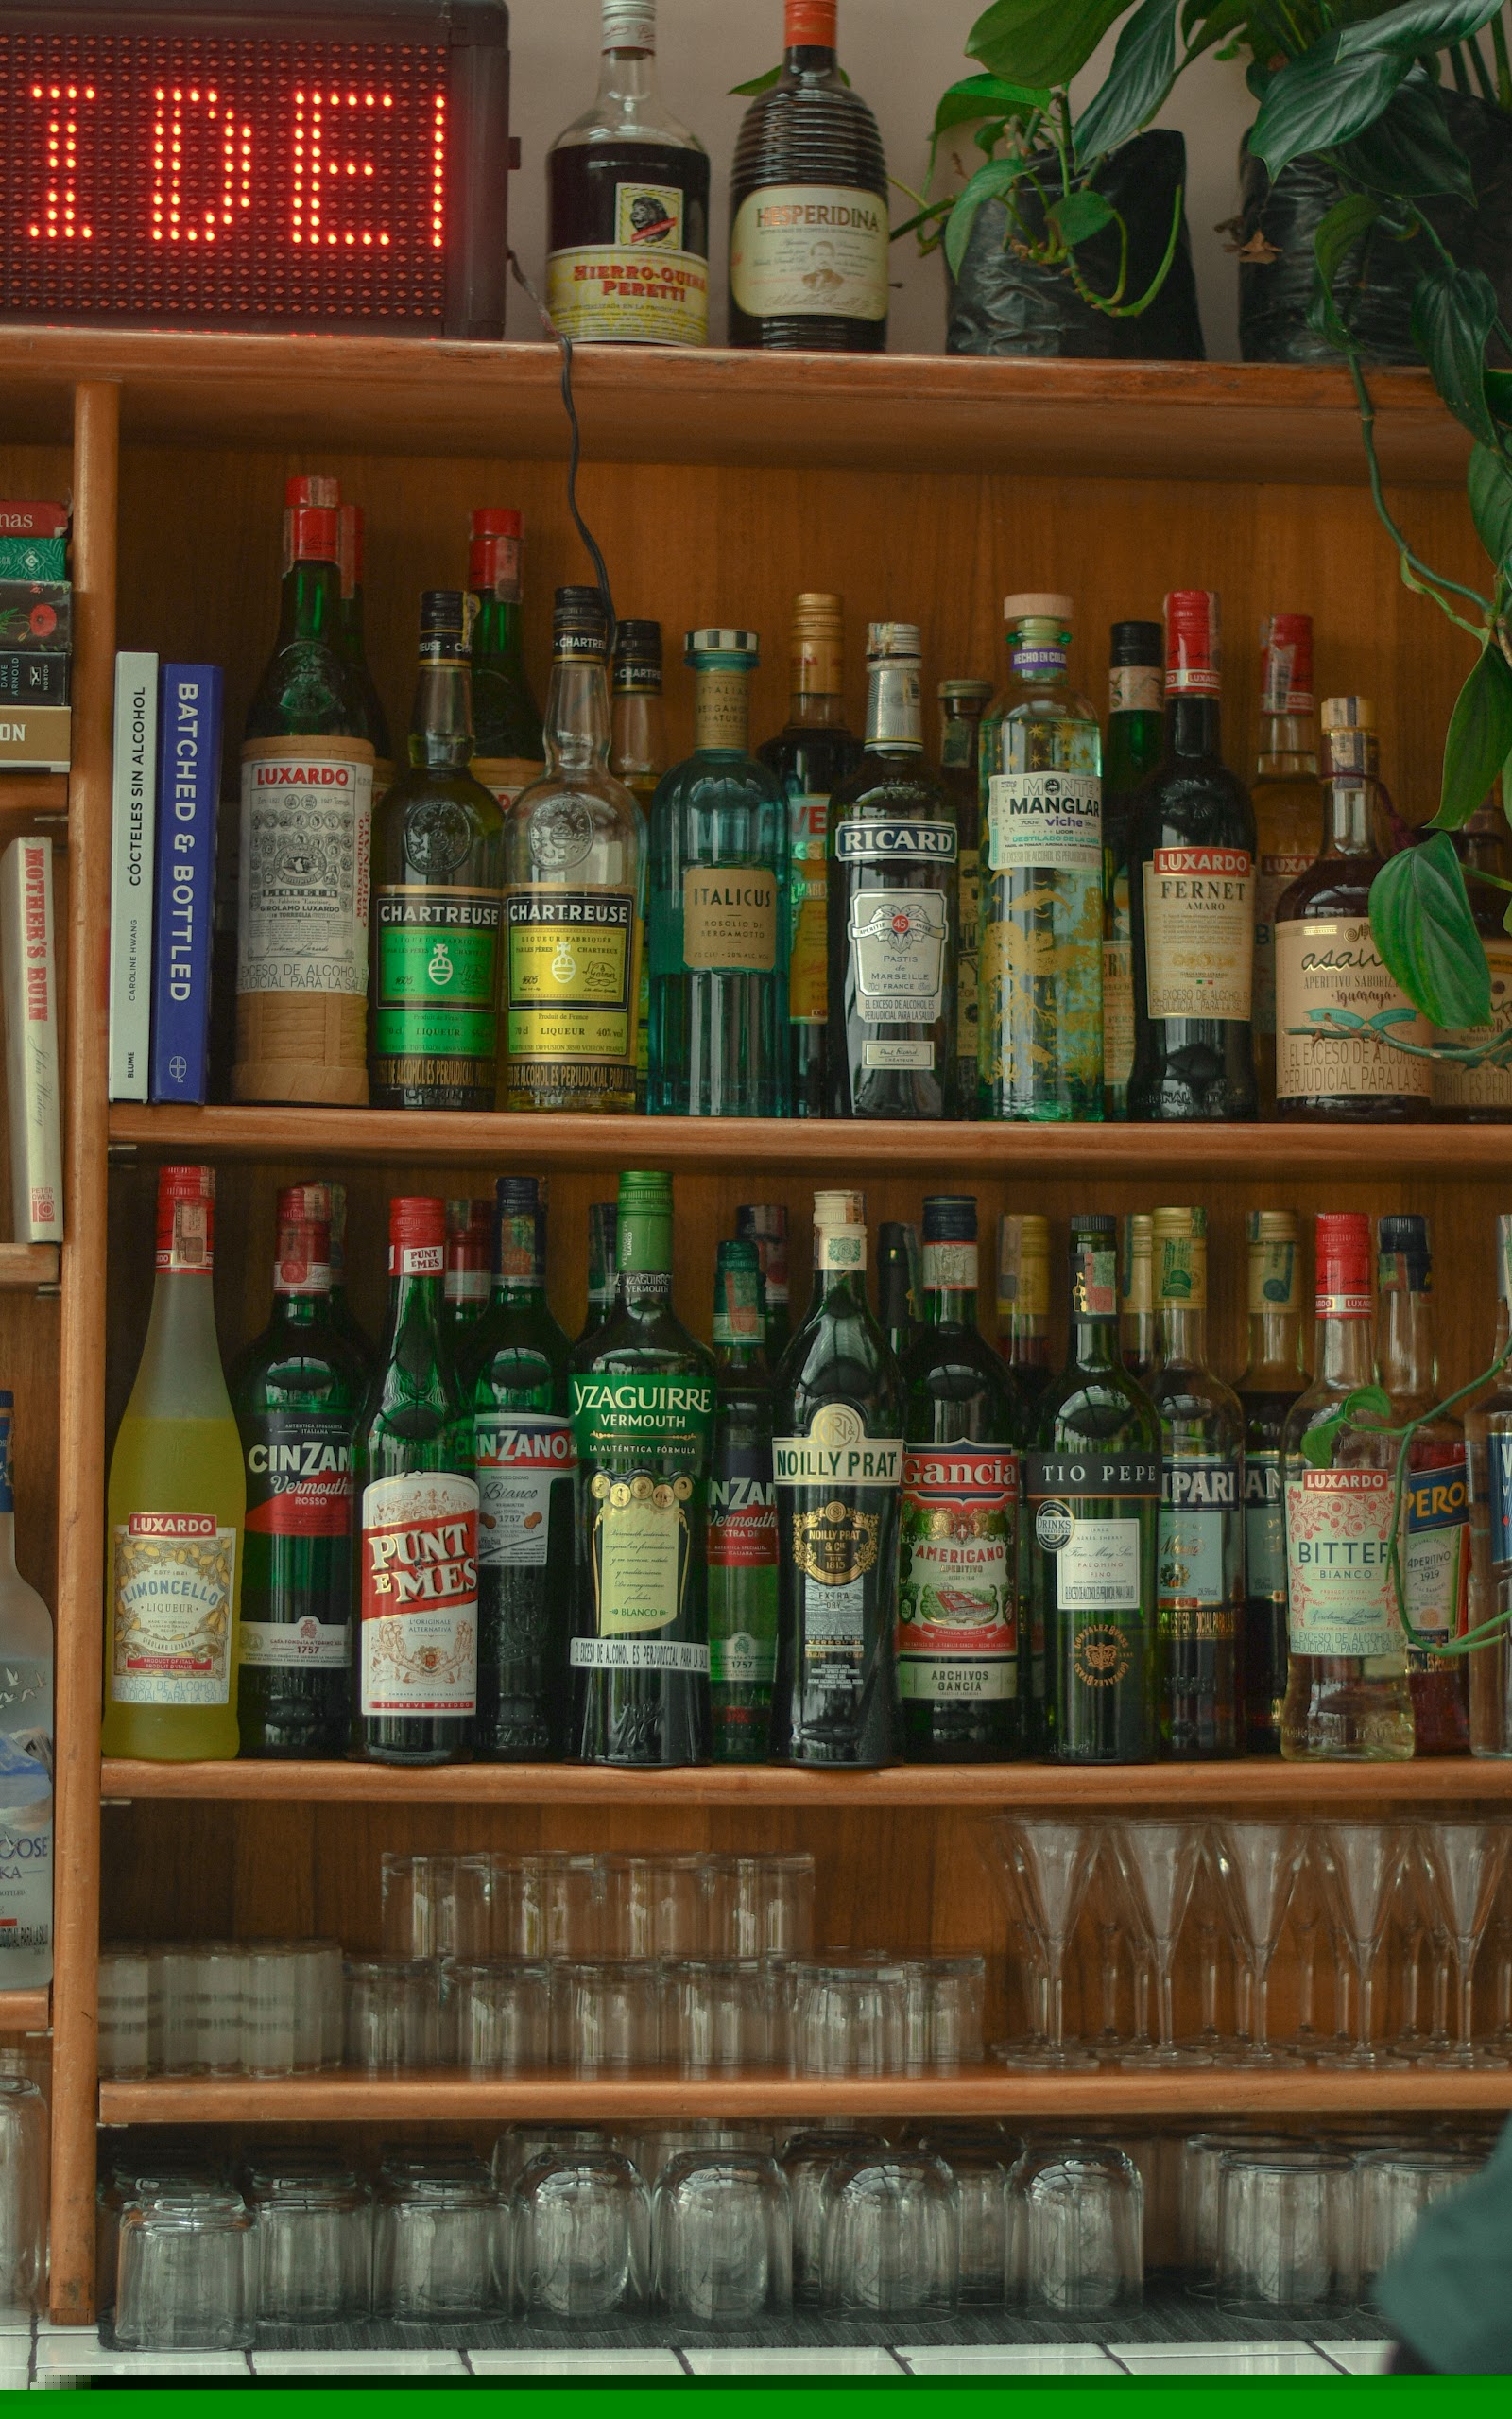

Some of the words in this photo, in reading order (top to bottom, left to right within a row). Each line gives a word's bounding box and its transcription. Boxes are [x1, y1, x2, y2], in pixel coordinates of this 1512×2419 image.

[29, 86, 452, 248] IDE
[756, 204, 880, 233] HESPERIDINA
[602, 280, 686, 302] PERETTI
[1013, 651, 1038, 664] HECHO
[1040, 652, 1048, 662] EN
[11, 657, 20, 697] ARNOLD
[132, 686, 146, 766] ALCOHOL
[175, 683, 200, 821] BATCHED
[131, 770, 144, 798] SIN
[257, 767, 349, 786] LUXARDO
[1009, 797, 1100, 818] MANGLAR
[1045, 815, 1083, 827] viche
[128, 802, 144, 887] CÓCTELES
[174, 833, 196, 854] &
[844, 829, 953, 852] RICARD
[1158, 852, 1247, 873] LUXARDO
[694, 888, 771, 907] ITALICUS
[1160, 880, 1246, 902] FERNET
[25, 847, 47, 959] MOTHER'S
[302, 905, 340, 913] LUXARDO
[1186, 901, 1226, 911] AMARO
[380, 905, 499, 925] CHARTREUSE
[509, 904, 628, 923] CHARTREUSE
[893, 918, 906, 929] 45
[129, 918, 138, 954] HWANG
[169, 864, 195, 1002] BOTTLED
[700, 930, 765, 939] BERGAMOTTO
[883, 955, 918, 963] PASTIS
[129, 956, 137, 1002] CAROLINE
[284, 963, 301, 976] DE
[306, 964, 359, 979] ALCOHOL
[871, 973, 929, 981] MARSEILLE
[290, 976, 323, 988] PARA
[328, 977, 341, 989] LA
[1304, 976, 1351, 990] APERITIVO
[27, 966, 49, 1022] RUIN
[1162, 989, 1194, 1001] EXCESO
[1195, 989, 1207, 1001] DE
[865, 999, 873, 1010] EL
[874, 999, 894, 1010] EXCESO
[895, 999, 902, 1010] DE
[902, 999, 927, 1010] ALCOHOL
[1200, 1000, 1220, 1011] PARA
[865, 1011, 897, 1021] PERJUDICIAL
[898, 1011, 910, 1021] PARA
[416, 1028, 460, 1037] LIQUEUR
[540, 1027, 586, 1037] LIQUEUR
[1289, 1043, 1300, 1067] EL
[1303, 1040, 1349, 1066] EXCESO
[1352, 1038, 1370, 1064] DE
[127, 1050, 135, 1079] BLUME
[520, 1064, 549, 1086] ALCOHOL
[550, 1065, 559, 1086] ES
[560, 1065, 608, 1088] PERJUDICIAL
[1285, 1067, 1356, 1094] PERJUDICIAL
[1361, 1067, 1394, 1092] PARA
[1397, 1068, 1409, 1092] LA
[410, 1249, 438, 1260] PUNT
[418, 1257, 441, 1269] MES
[574, 1380, 712, 1415] YZAGUIRRE
[600, 1414, 686, 1428] VERMOUTH
[479, 1429, 567, 1461] NZANO
[598, 1443, 652, 1453] AUTÉNTICA
[656, 1443, 696, 1454] FÓRMULA
[776, 1449, 841, 1476] NOILLY
[847, 1450, 897, 1477] PRAT
[902, 1458, 1016, 1485] Gancia
[1042, 1464, 1086, 1482] TIO
[1102, 1464, 1156, 1482] PEPE
[270, 1475, 350, 1495] Vermouth
[1163, 1470, 1234, 1503] PARI
[1307, 1474, 1384, 1488] LUXARDO
[482, 1481, 539, 1500] Bianco
[294, 1496, 328, 1506] ROSSO
[133, 1517, 212, 1533] LUXARDO
[498, 1514, 521, 1523] 1757
[1037, 1516, 1072, 1530] DRINKS
[809, 1529, 837, 1540] NOILLY
[839, 1529, 861, 1541] PRAT
[369, 1522, 469, 1572] PUNT
[824, 1542, 833, 1552] &
[915, 1545, 1004, 1564] AMERICANO
[826, 1561, 846, 1569] 1813
[1407, 1551, 1452, 1569] APERITIVO
[940, 1564, 983, 1573] APERITIVO
[1319, 1569, 1372, 1579] BIANCO
[1420, 1570, 1440, 1581] 1919
[372, 1573, 392, 1595] E
[393, 1557, 478, 1604] MES
[124, 1580, 219, 1606] LIMONCELLO
[818, 1591, 850, 1600] EXTRA
[146, 1603, 193, 1613] LIQUEUR
[621, 1608, 658, 1616] BLANCO
[1298, 1632, 1332, 1644] EXCESO
[1334, 1633, 1348, 1644] DE
[1352, 1632, 1391, 1644] ALCOHOL
[297, 1646, 319, 1654] 1757
[606, 1644, 629, 1665] ALCOHOL
[632, 1645, 640, 1665] ES
[681, 1647, 692, 1667] PARA
[1340, 1643, 1365, 1654] PARA
[1367, 1644, 1379, 1654] LA
[731, 1661, 753, 1669] 1757
[932, 1670, 988, 1681] ARCHIVOS
[156, 1680, 168, 1691] DE
[174, 1680, 215, 1692] ALCOHOL
[937, 1682, 982, 1692] GANCIA
[162, 1690, 186, 1702] PARA
[190, 1691, 201, 1702] LA
